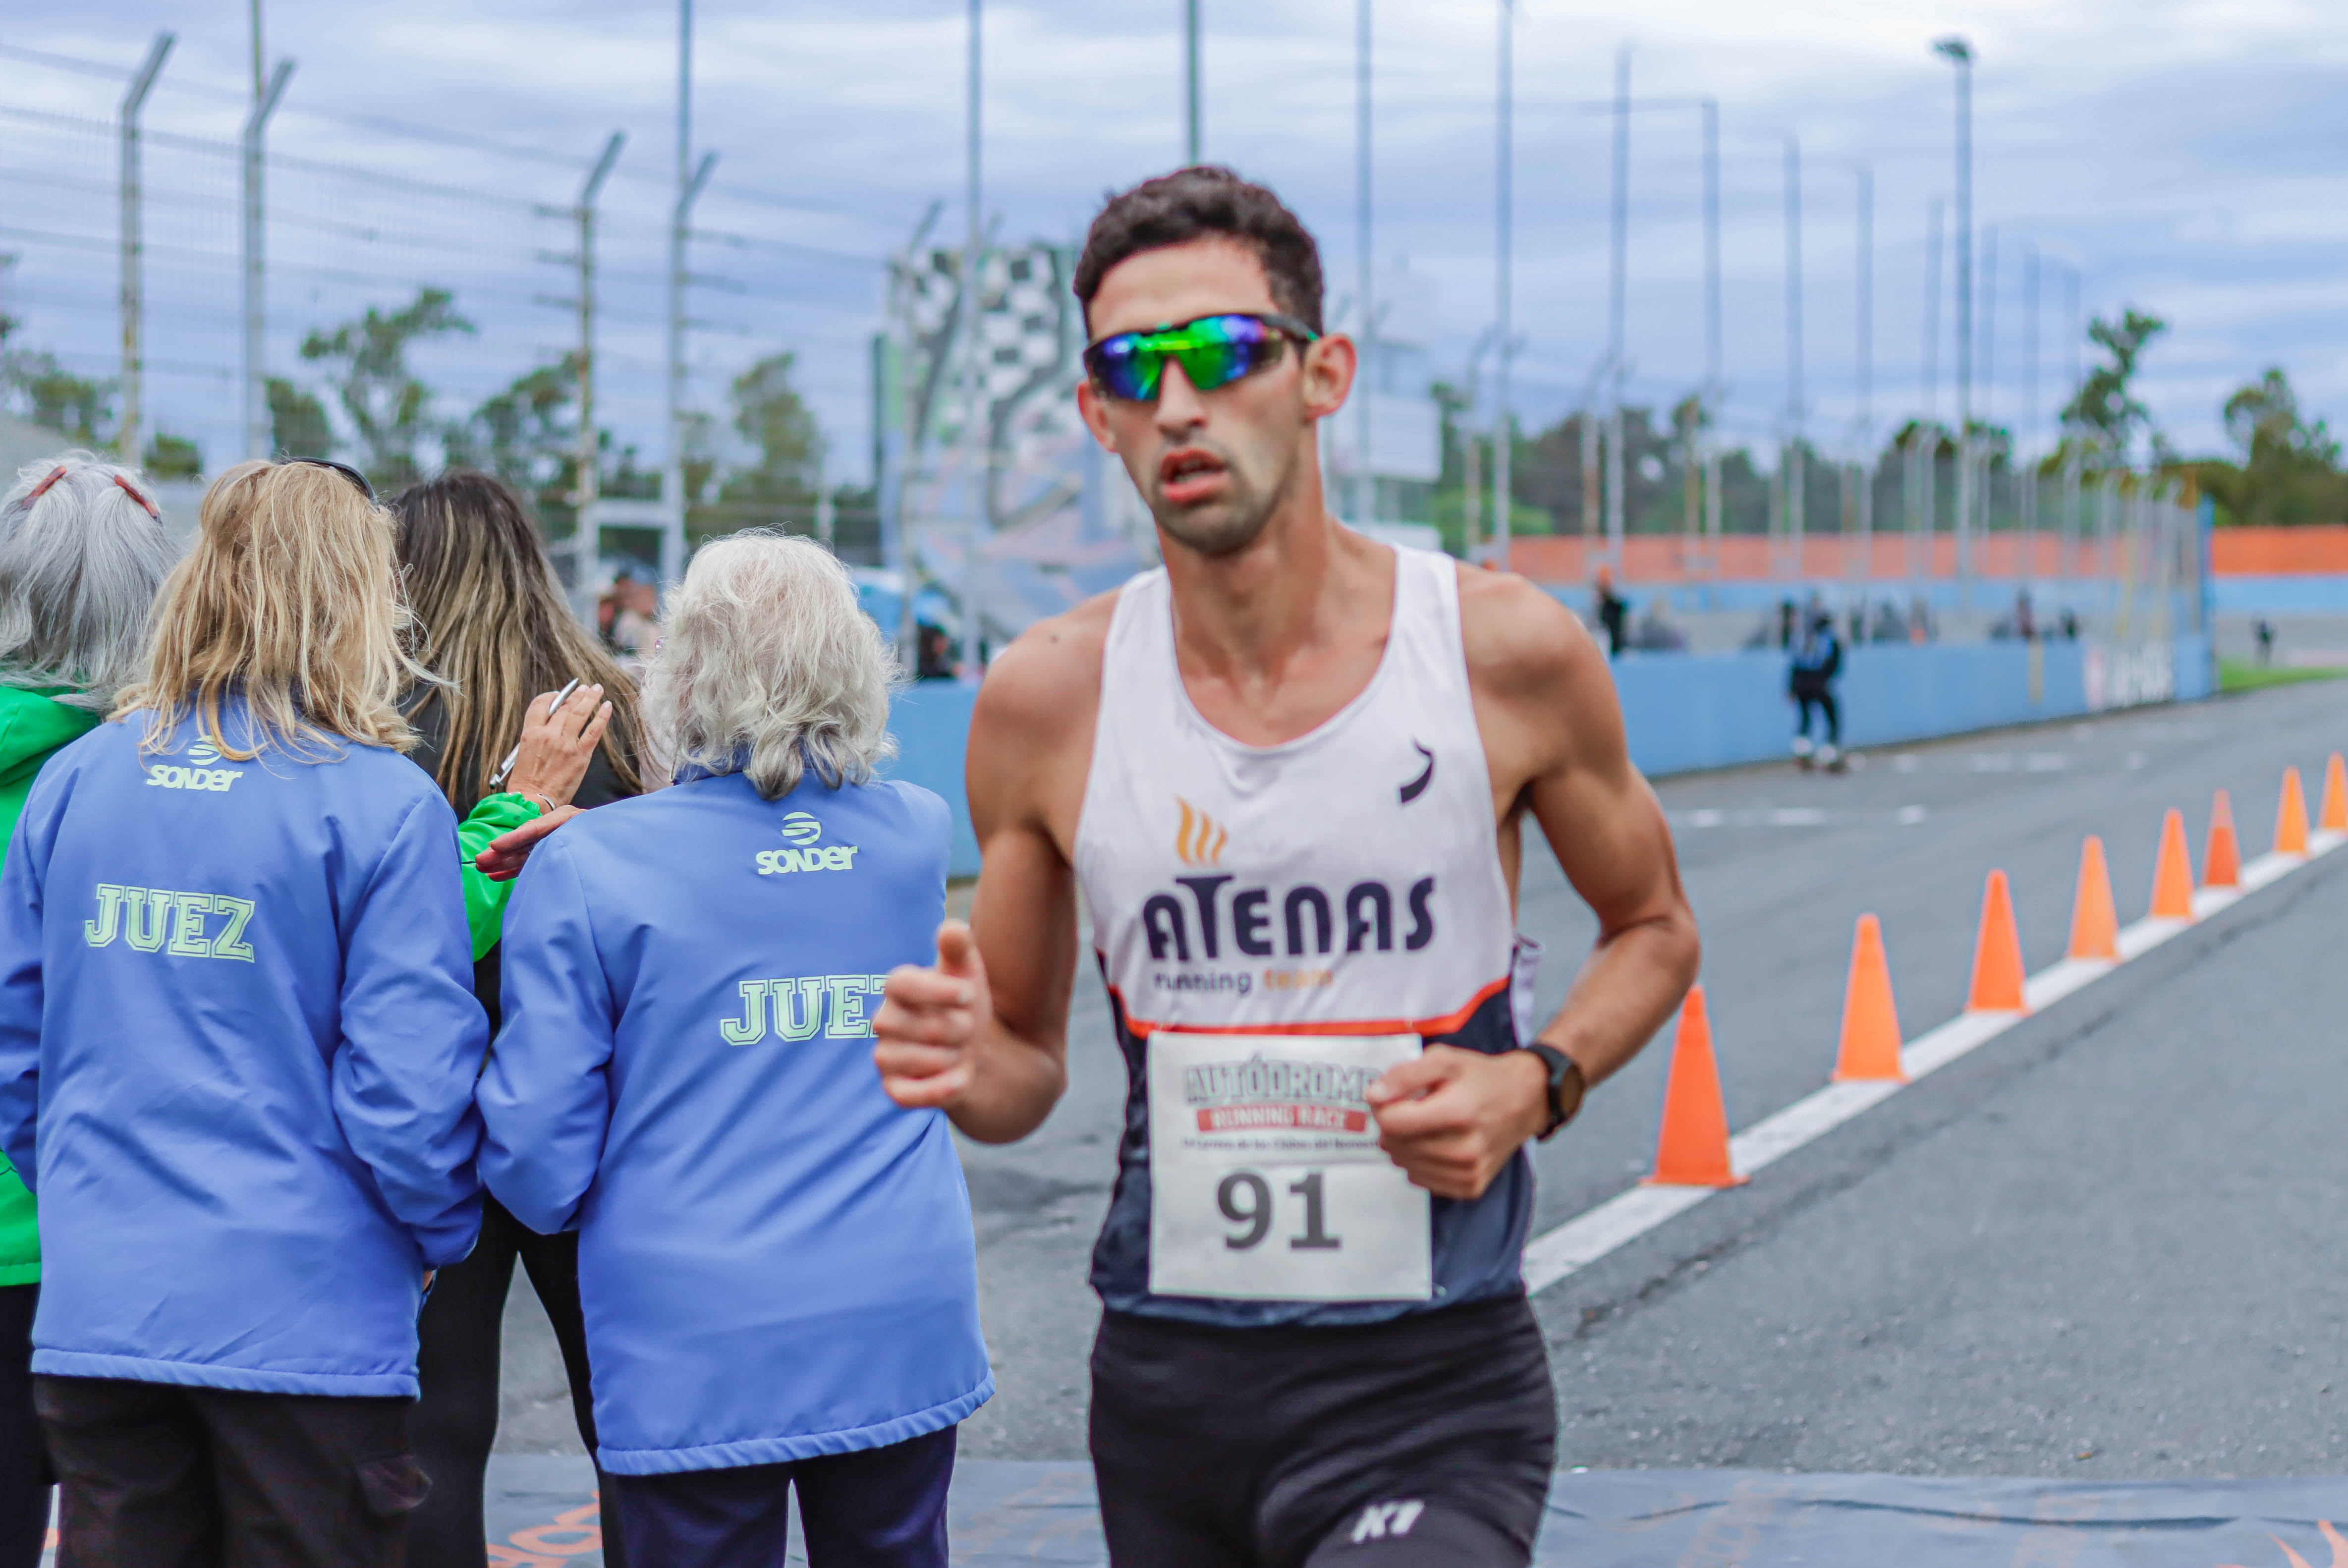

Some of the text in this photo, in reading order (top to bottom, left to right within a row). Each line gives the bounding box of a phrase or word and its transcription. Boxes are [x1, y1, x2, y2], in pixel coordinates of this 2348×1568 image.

[85, 884, 255, 963] JUEZ
[1154, 972, 1252, 996] running
[1211, 1106, 1294, 1128] RUNNING
[1217, 1173, 1341, 1250] 91
